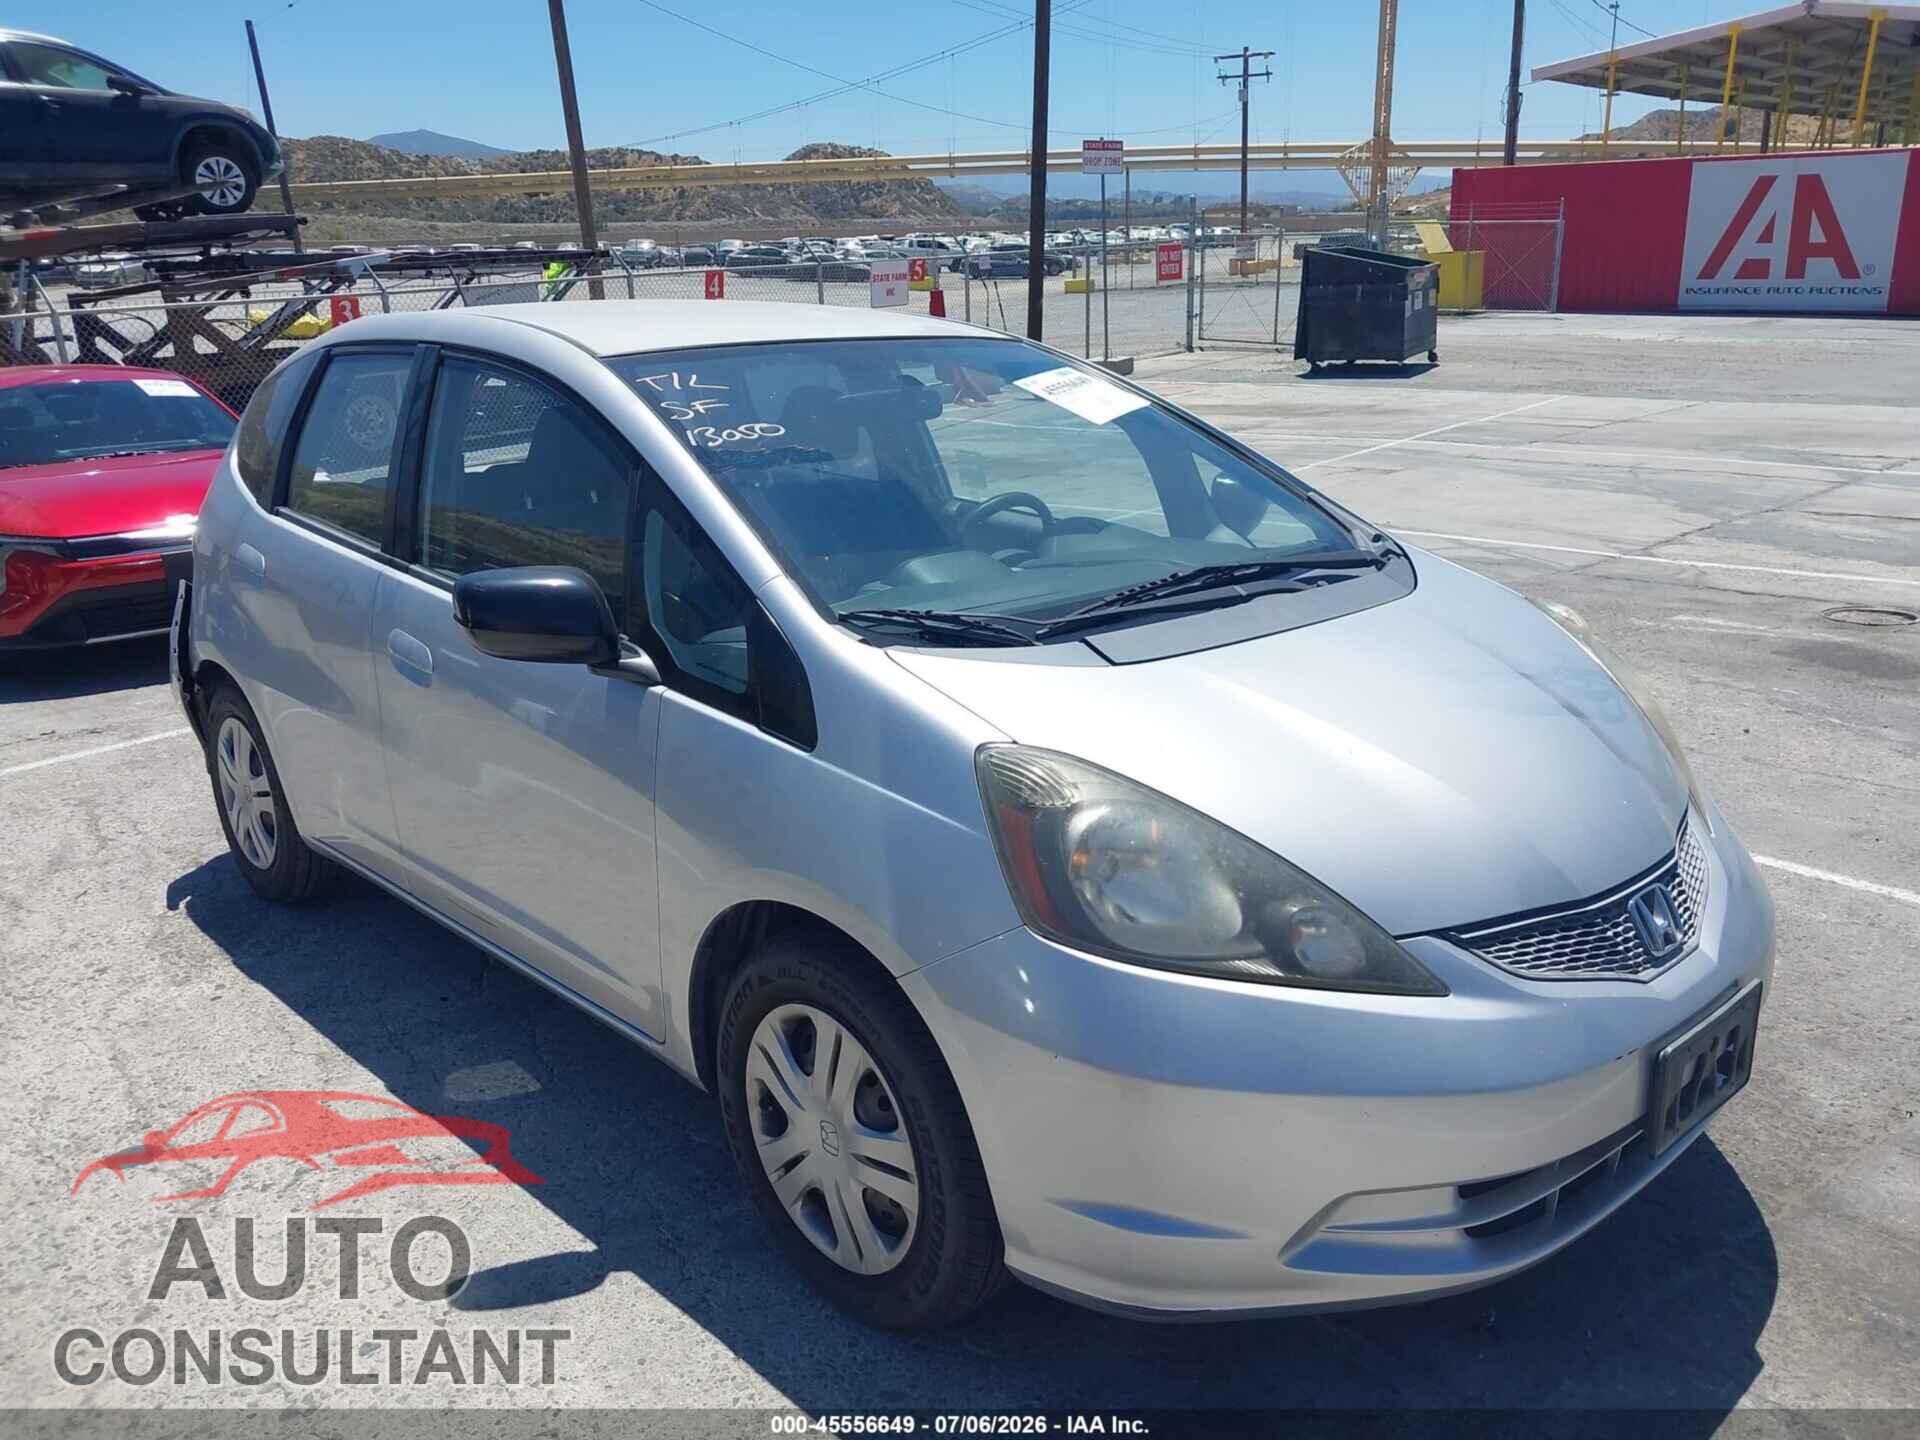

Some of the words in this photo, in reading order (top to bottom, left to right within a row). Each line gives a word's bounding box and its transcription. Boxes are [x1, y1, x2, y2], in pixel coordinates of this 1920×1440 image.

[1083, 156, 1103, 166] DROP
[1104, 156, 1121, 166] ZONE
[1159, 251, 1168, 262] DO
[1169, 250, 1181, 261] NOT
[913, 260, 923, 280] 5
[1160, 263, 1180, 274] ENTER
[872, 273, 890, 283] STATE
[891, 271, 907, 280] FARM
[709, 274, 720, 297] 4
[1685, 286, 1761, 295] INSURANCE
[1766, 286, 1804, 295] AUTO
[1808, 286, 1883, 295] AUCTIONS
[338, 300, 353, 325] 3
[660, 399, 730, 420] SF
